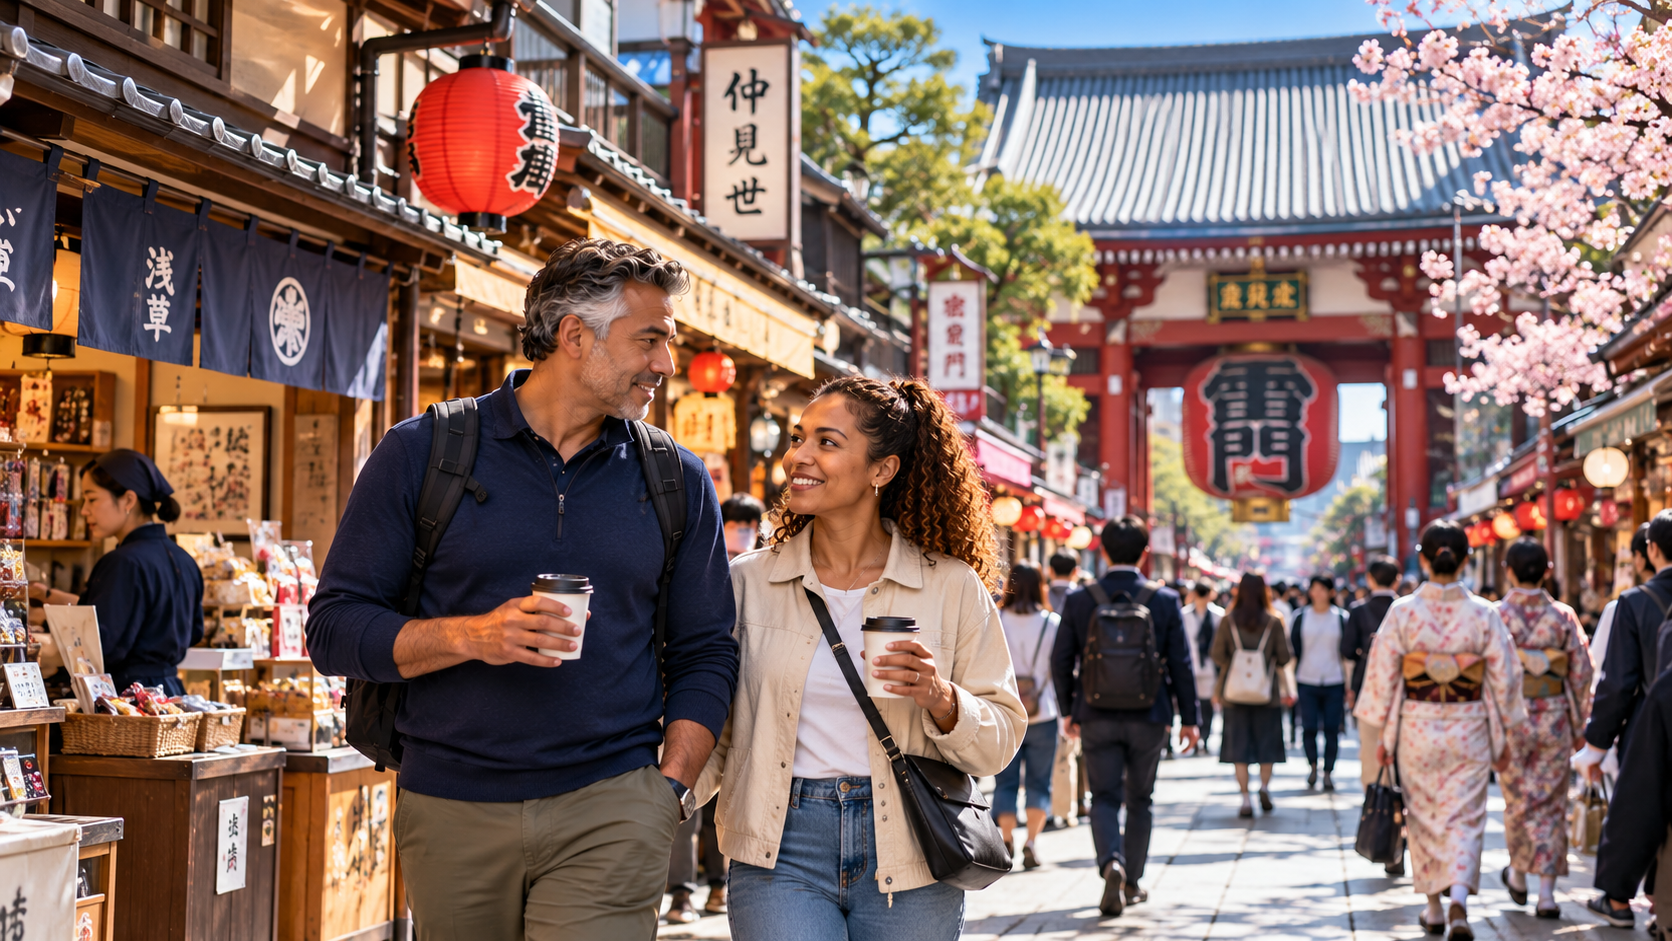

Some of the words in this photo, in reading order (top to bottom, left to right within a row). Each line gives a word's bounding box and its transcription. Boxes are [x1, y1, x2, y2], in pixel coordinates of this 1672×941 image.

[723, 68, 770, 215] 仲見世
[143, 246, 175, 343] 浅草
